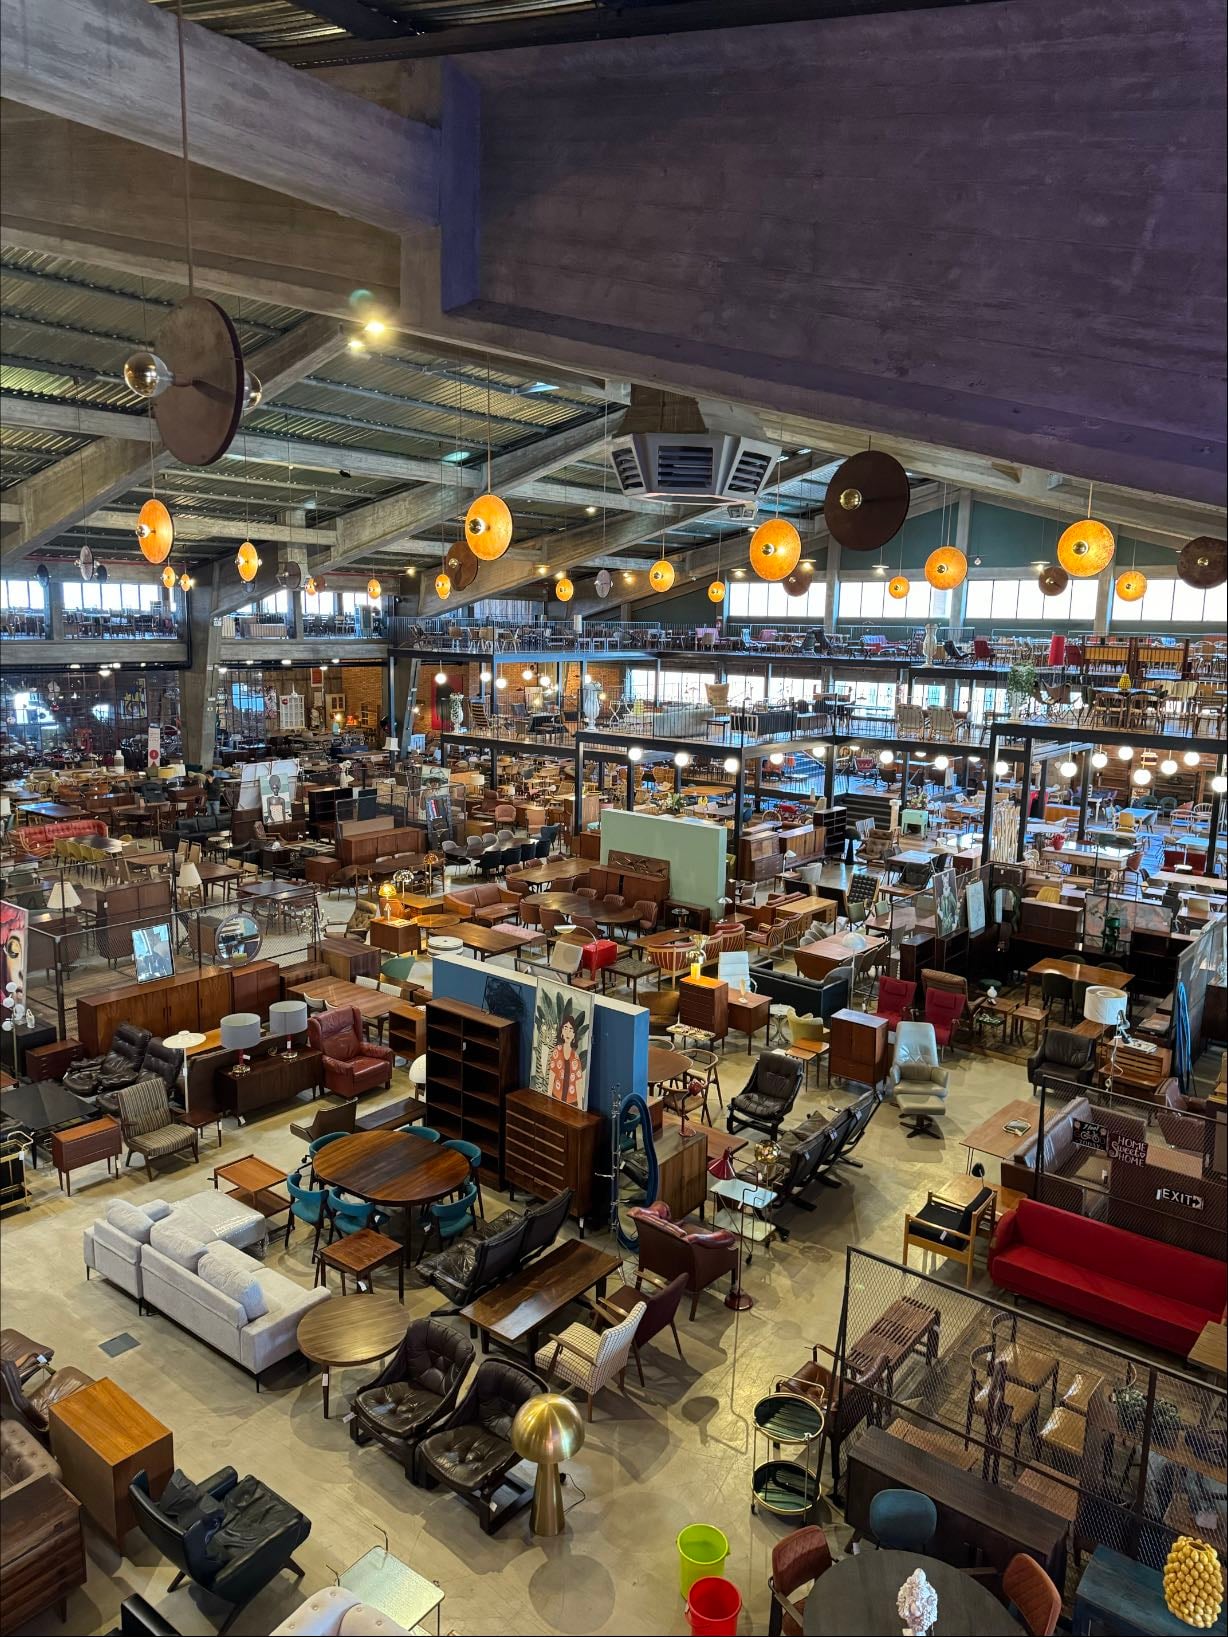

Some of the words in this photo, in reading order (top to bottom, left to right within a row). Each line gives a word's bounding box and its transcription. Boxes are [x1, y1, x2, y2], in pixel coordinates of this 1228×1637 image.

[1109, 1141, 1139, 1157] Sweet
[1118, 1135, 1147, 1152] HOME
[1118, 1153, 1144, 1167] HOME
[1163, 1188, 1192, 1205] EXIT
